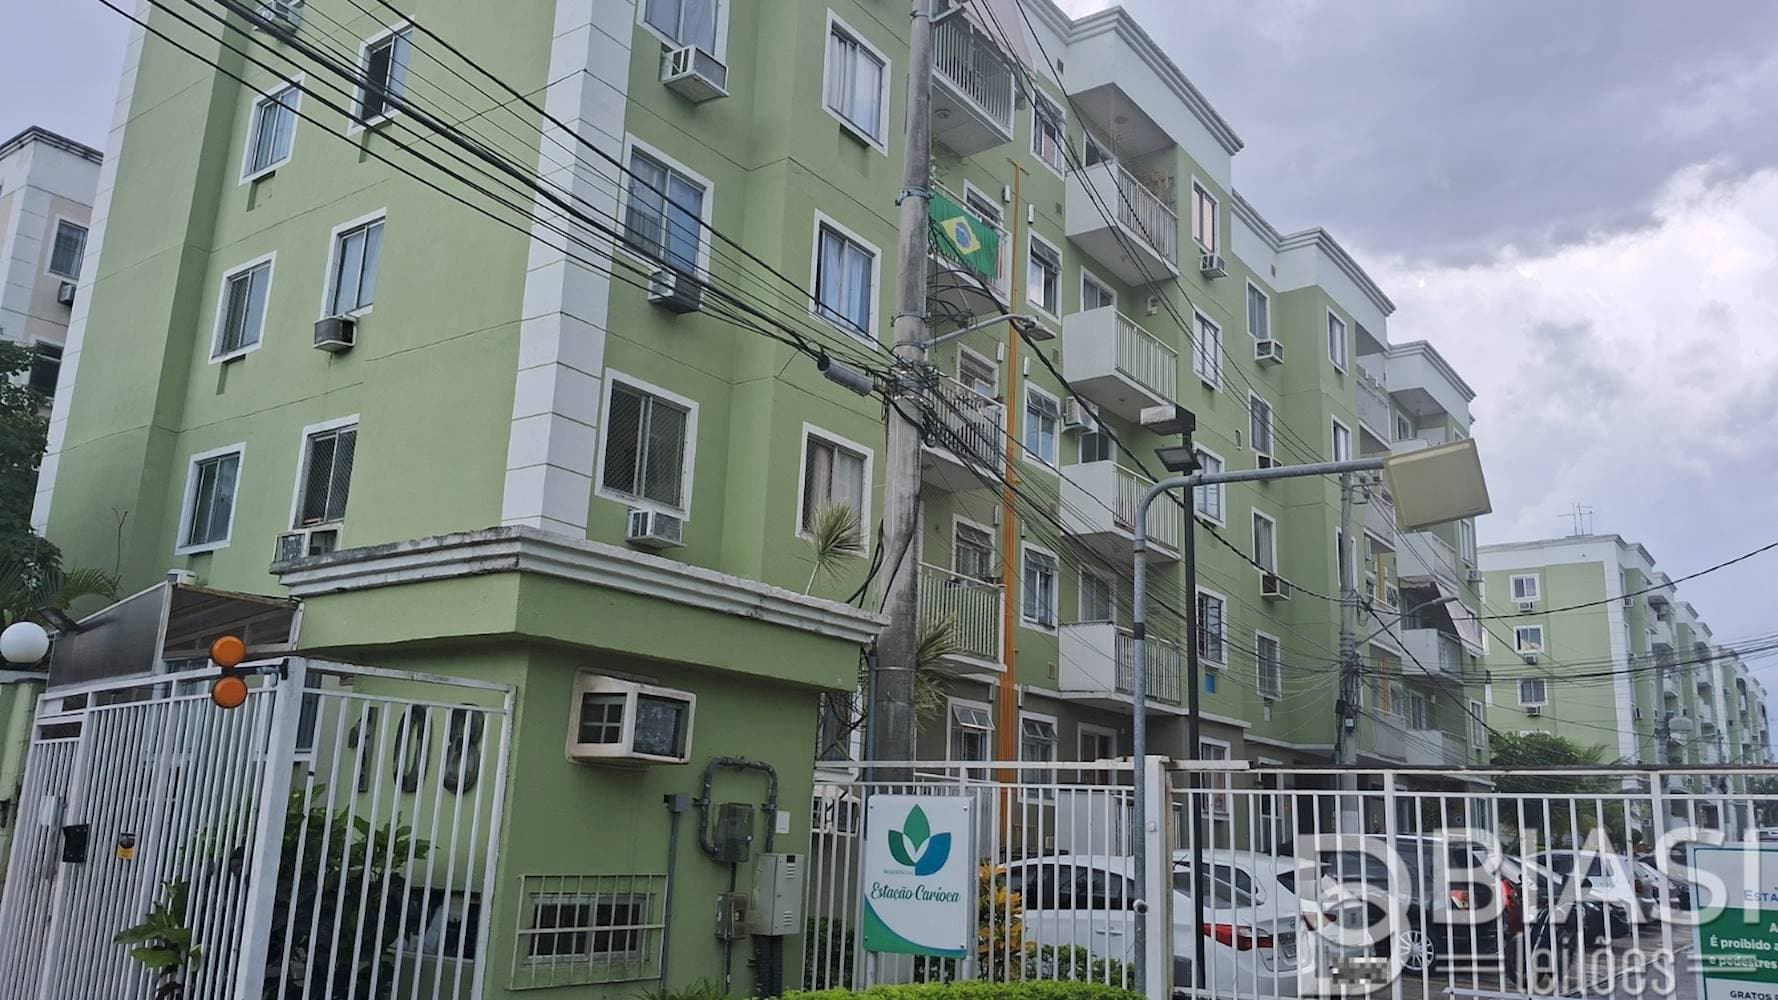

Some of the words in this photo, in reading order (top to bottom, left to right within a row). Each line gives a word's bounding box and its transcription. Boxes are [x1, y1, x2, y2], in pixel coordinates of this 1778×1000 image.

[348, 703, 484, 795] 108
[871, 882, 913, 900] Estação
[915, 884, 960, 902] Carioca
[1710, 934, 1719, 947] É
[1720, 938, 1771, 951] proibido
[1719, 957, 1777, 969] pedestres
[1730, 990, 1773, 1000] GRATOS
